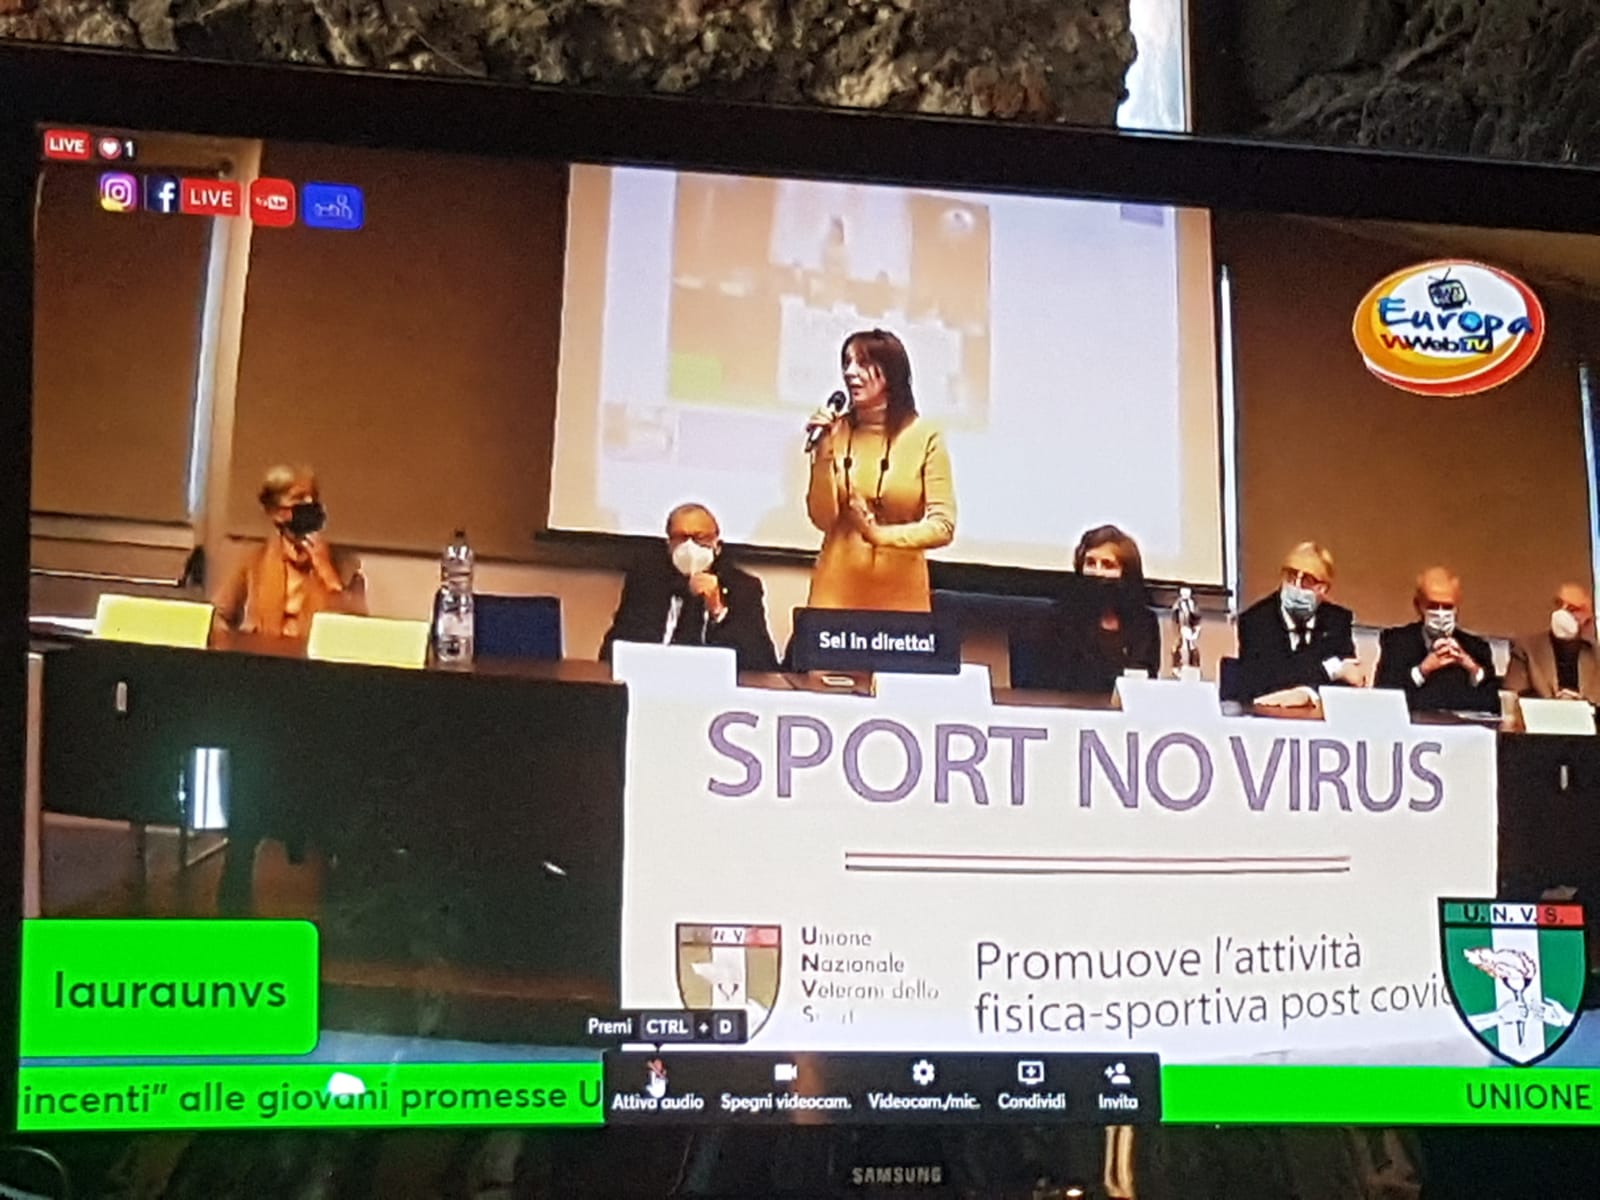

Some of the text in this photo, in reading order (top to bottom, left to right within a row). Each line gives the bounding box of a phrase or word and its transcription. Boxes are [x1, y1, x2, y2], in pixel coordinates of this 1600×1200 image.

[50, 137, 86, 153] LIVE
[125, 140, 134, 157] 1
[190, 188, 234, 208] LIVE
[1379, 297, 1533, 343] Europa
[871, 632, 935, 653] diretta!
[707, 711, 1445, 813] SPORT NO VIRUS
[801, 952, 905, 973] Nazionale
[976, 941, 1202, 981] Promuove
[55, 972, 287, 1008] lauraunvs
[975, 988, 1267, 1040] fisica-sportiva
[1281, 985, 1361, 1032] post
[588, 1018, 632, 1034] Premi
[646, 1019, 689, 1035] CTRL
[719, 1019, 732, 1035] D
[179, 1081, 246, 1112] alle
[257, 1080, 389, 1119] giovani
[401, 1080, 567, 1118] promesse
[611, 1093, 704, 1110] Attiva audio
[720, 1093, 852, 1113] Spegni videocam.
[998, 1093, 1066, 1109] Condividi
[1098, 1094, 1139, 1109] Invita
[1467, 1083, 1593, 1110] UNIONE
[852, 1167, 942, 1184] SAMSUNG
